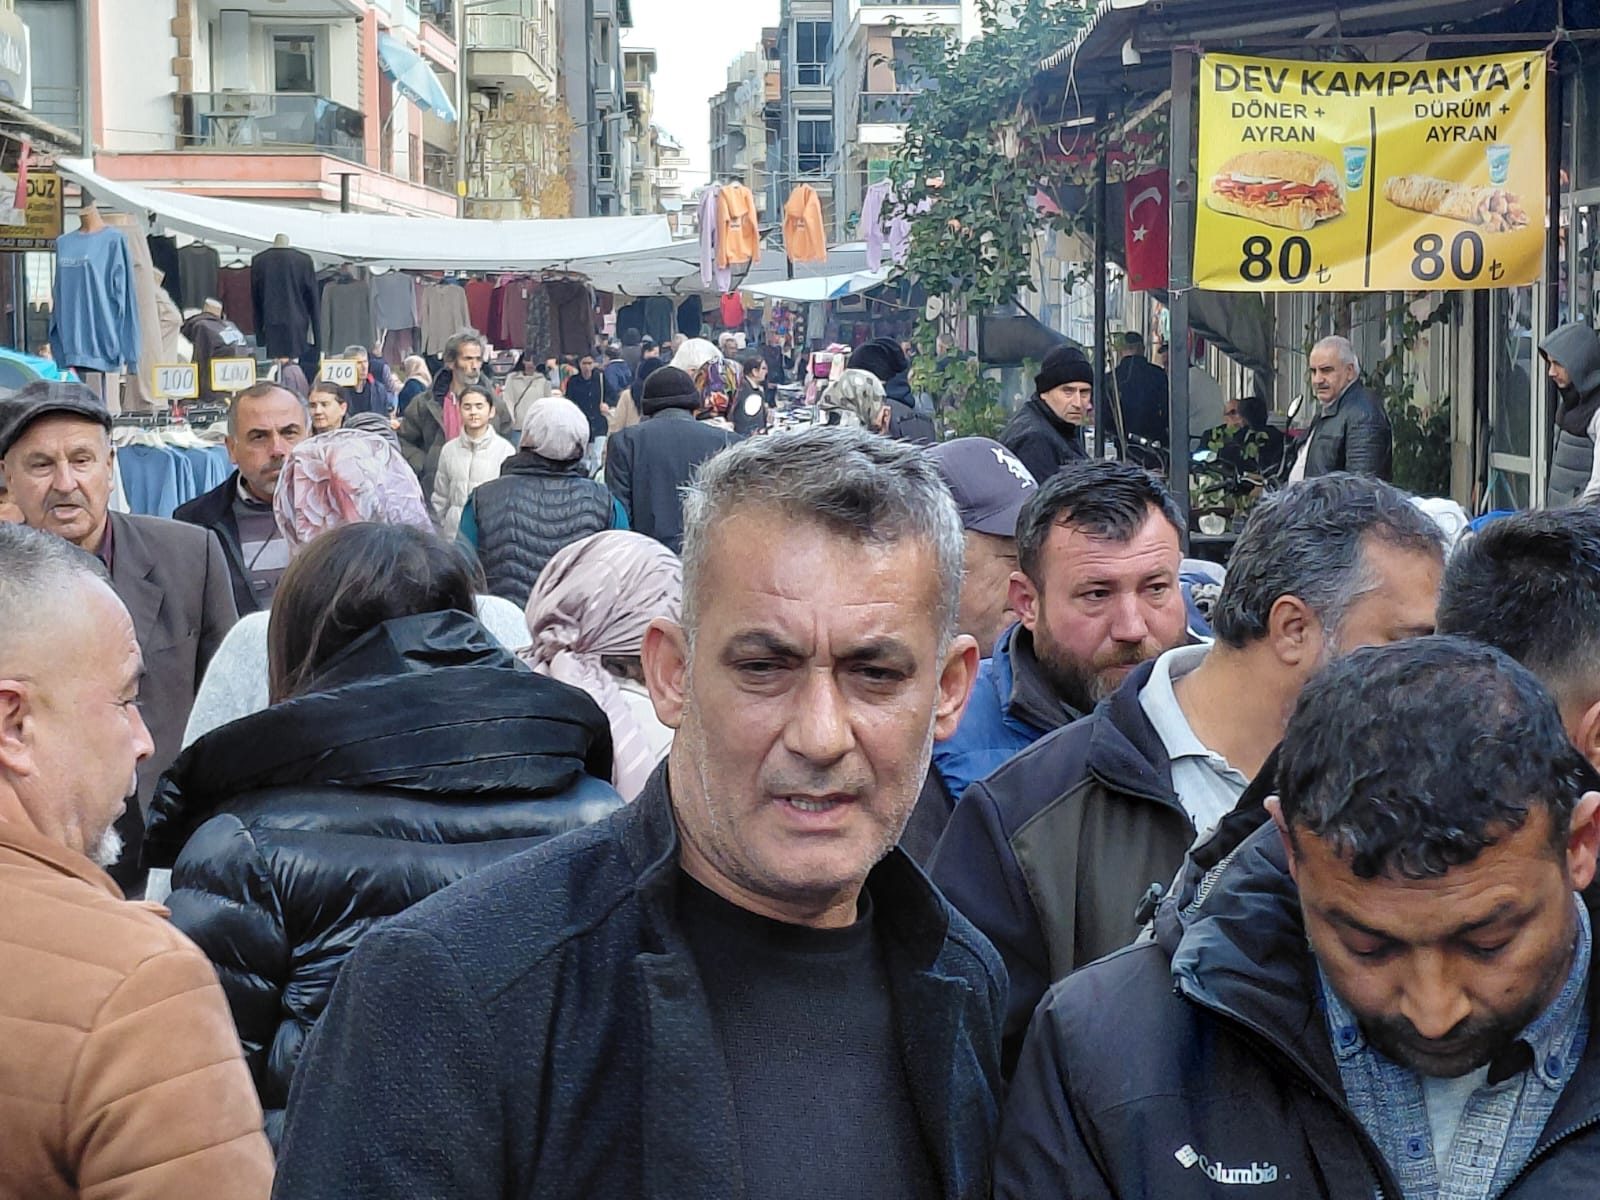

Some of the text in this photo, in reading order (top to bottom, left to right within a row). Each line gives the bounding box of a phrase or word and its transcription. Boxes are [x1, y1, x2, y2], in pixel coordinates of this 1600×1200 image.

[1214, 63, 1290, 93] DEV
[1300, 63, 1510, 97] KAMPANYA
[1231, 98, 1308, 119] DÖNER
[1414, 98, 1491, 118] DÜRÜM
[1241, 125, 1316, 143] AYRAN
[1425, 125, 1498, 143] AYRAN
[161, 368, 195, 391] 100
[326, 365, 354, 380] 100
[1198, 1154, 1278, 1185] Columbia
